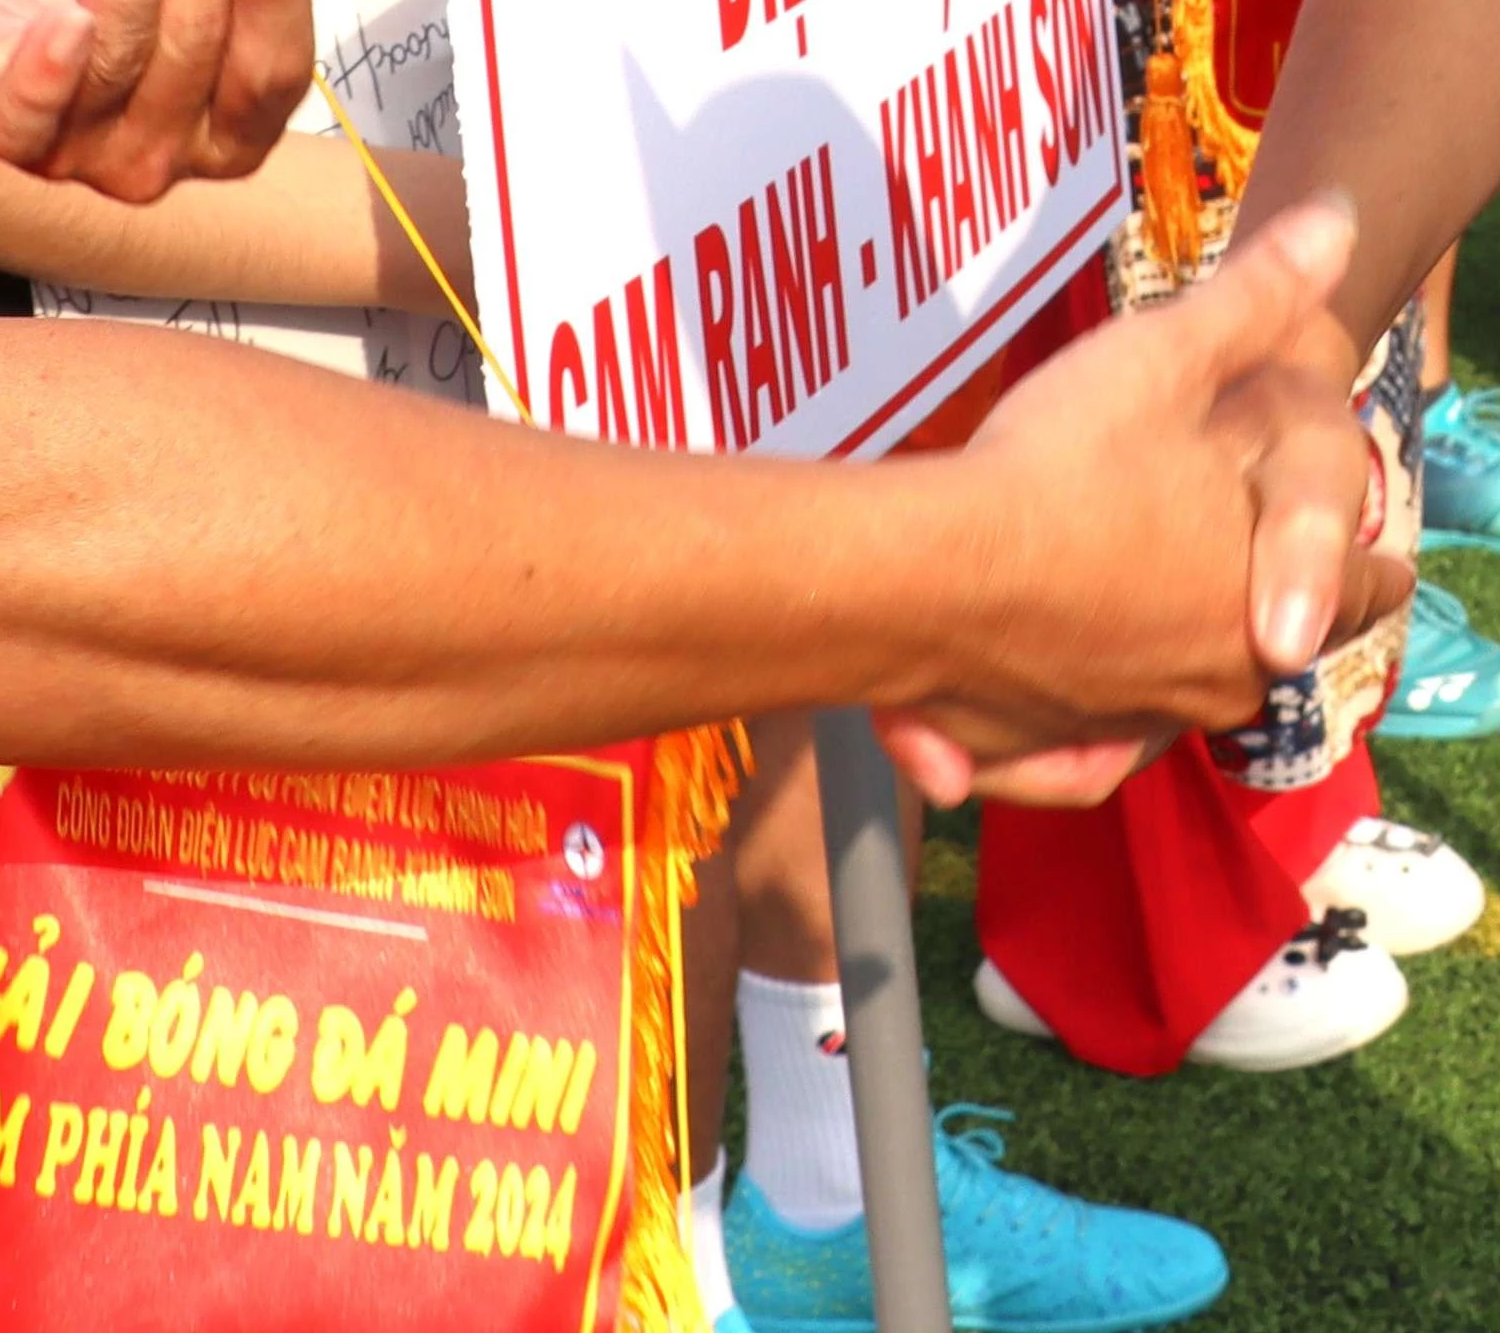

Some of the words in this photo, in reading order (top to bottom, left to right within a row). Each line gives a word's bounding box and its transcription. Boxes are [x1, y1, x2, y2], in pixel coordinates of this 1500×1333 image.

[694, 142, 850, 454] RANH
[56, 773, 111, 849] CÔNG
[116, 790, 175, 862] ĐOÀN
[178, 800, 233, 880] ĐIỆN
[234, 815, 278, 889] LỰC
[279, 824, 329, 892] CAM
[102, 950, 299, 1093] BÓNG
[311, 988, 418, 1112] ĐÁ
[423, 1023, 597, 1134] MINI
[35, 1085, 178, 1216] PHÍA
[193, 1123, 321, 1235] NAM
[327, 1123, 458, 1251] NĂM
[463, 1157, 578, 1273] 2024
